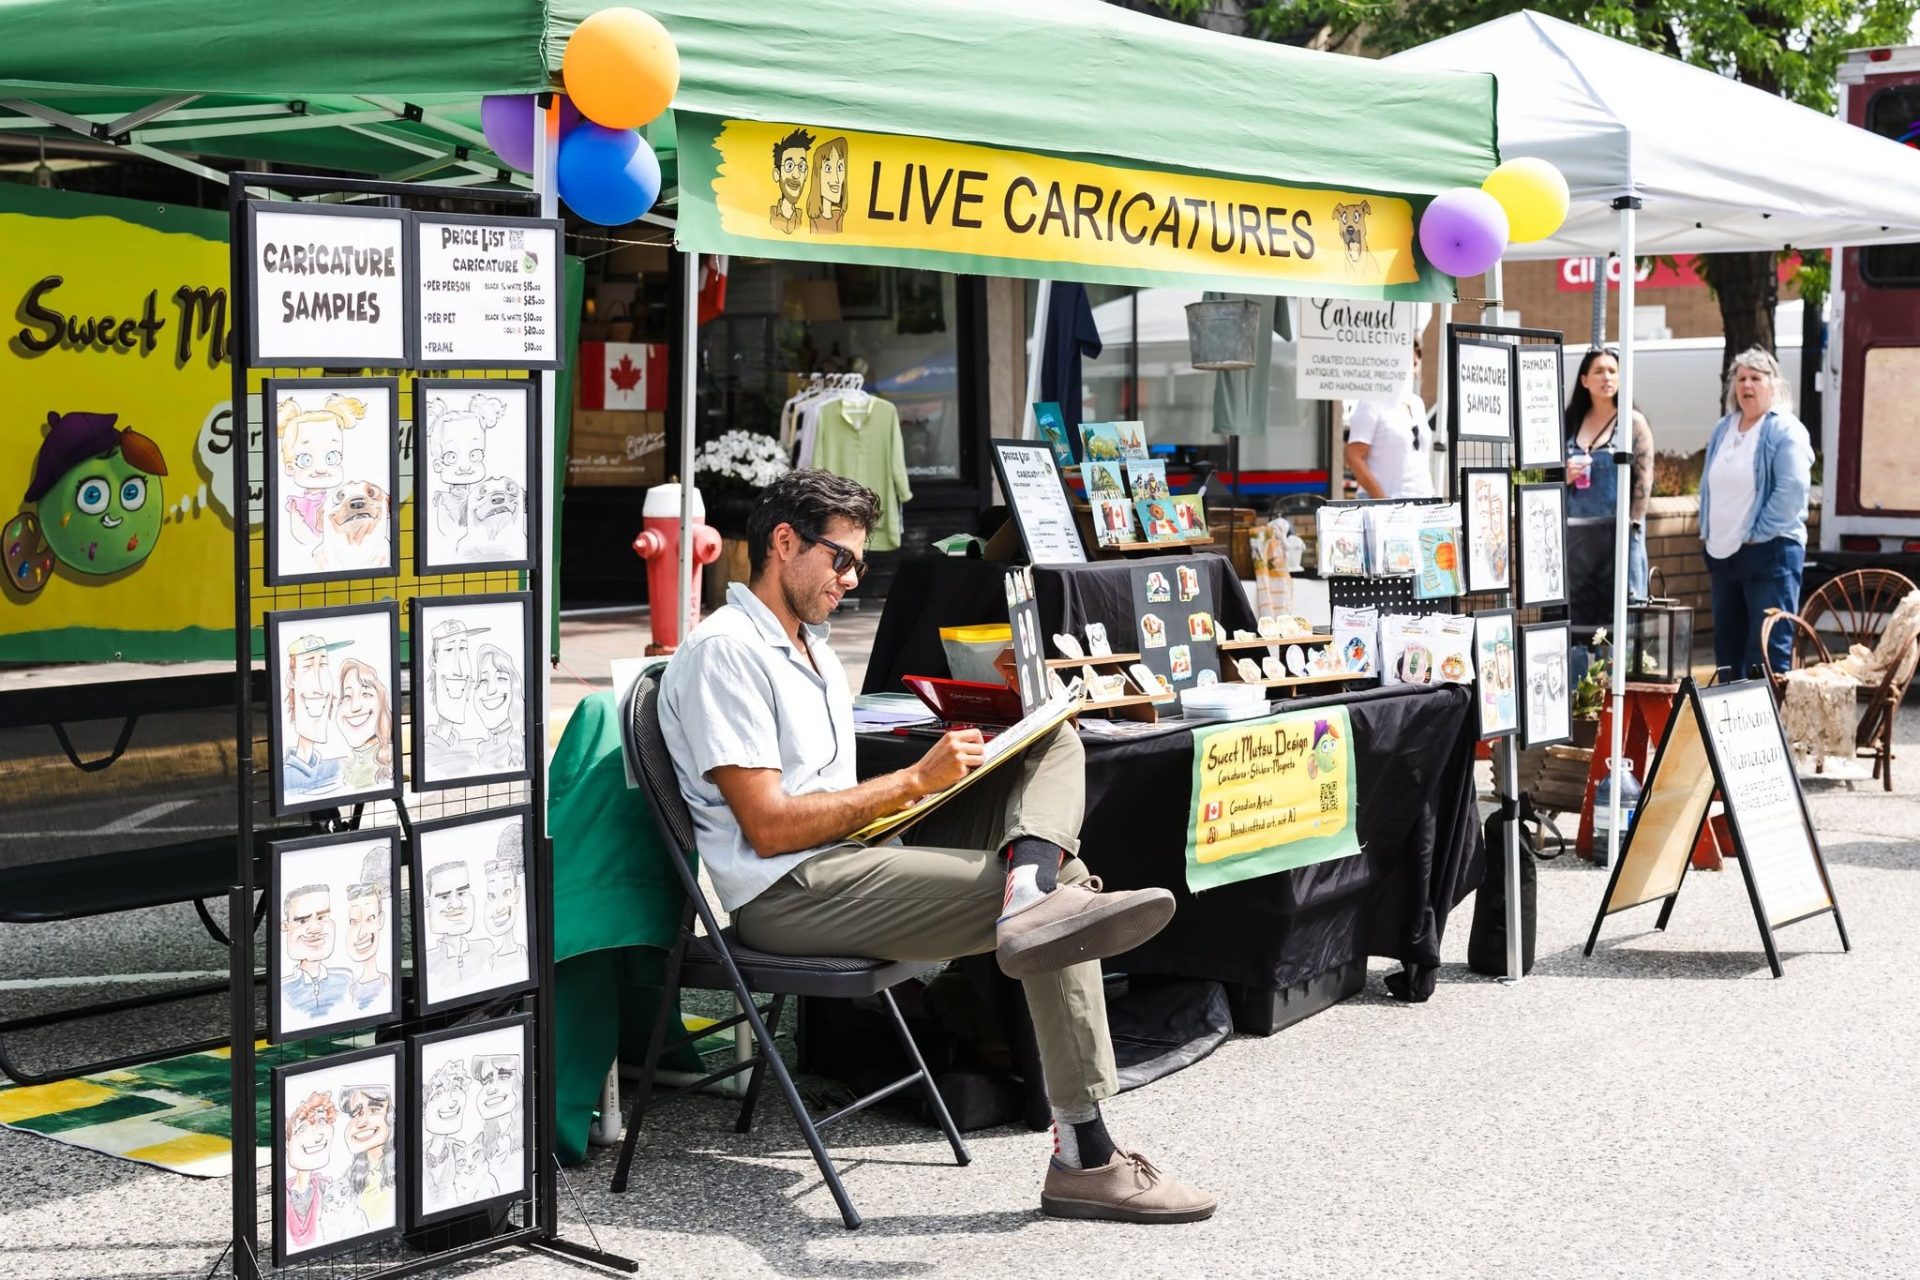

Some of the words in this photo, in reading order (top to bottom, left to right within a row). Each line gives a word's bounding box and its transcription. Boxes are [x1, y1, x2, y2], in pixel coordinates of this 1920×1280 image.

[868, 160, 989, 229] LIVE
[1003, 176, 1315, 260] CARICATURES
[442, 280, 471, 293] PERSON
[281, 290, 381, 324] SAMPLES
[524, 295, 546, 306] $25.00
[18, 274, 166, 352] Sweet
[443, 312, 456, 324] PET
[1311, 297, 1397, 330] Carousel
[524, 325, 546, 336] $20.00
[1336, 329, 1407, 346] COLLECTIVE
[428, 342, 453, 353] FRAME
[1312, 354, 1343, 365] CURATED
[1345, 356, 1389, 367] COLLECTIONS
[1390, 358, 1400, 367] OF
[1319, 381, 1334, 390] AND
[1335, 382, 1373, 392] HANDMADE
[1374, 383, 1393, 393] ITEMS
[1466, 393, 1501, 416] SAMPLES
[1207, 741, 1238, 771] Sweet
[1241, 734, 1273, 764] Mutsu
[1274, 729, 1309, 757] Design
[1229, 798, 1256, 815] Canadian
[1256, 793, 1273, 810] Artist
[1229, 820, 1265, 837] Handcrafted
[1277, 815, 1287, 826] not
[1288, 807, 1297, 823] AI
